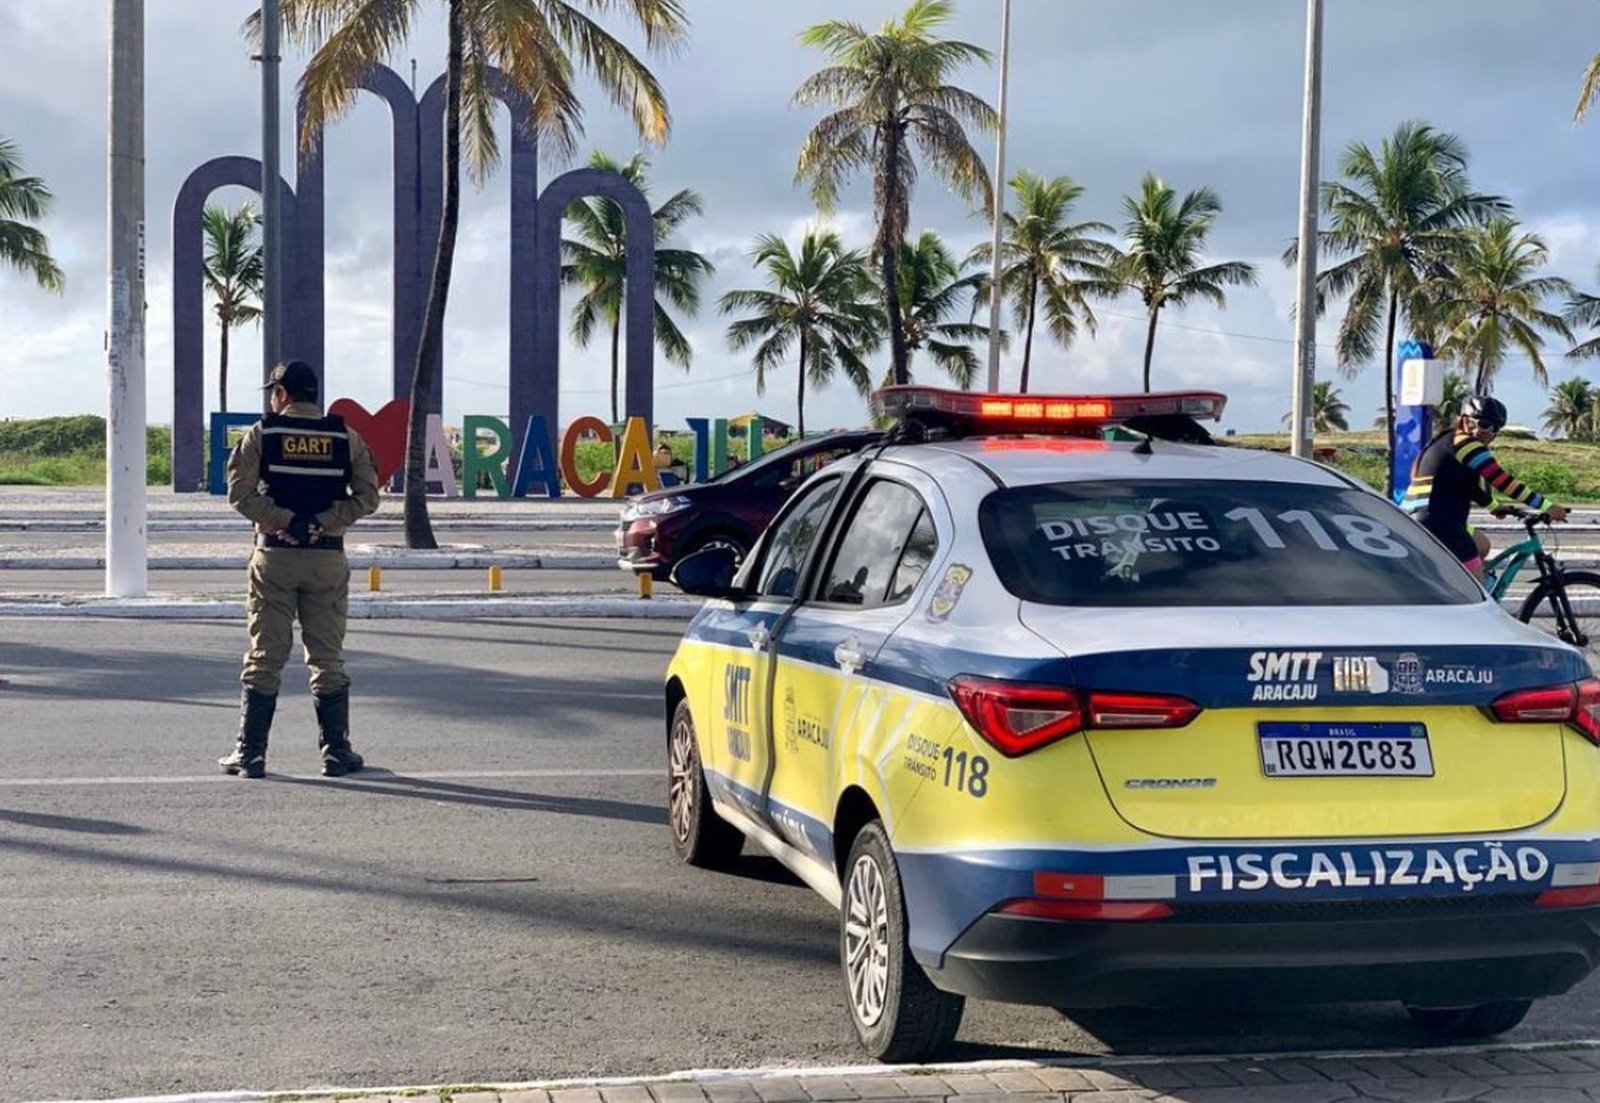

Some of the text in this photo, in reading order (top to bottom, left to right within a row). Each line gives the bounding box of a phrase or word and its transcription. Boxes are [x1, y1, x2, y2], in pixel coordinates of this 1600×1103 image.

[284, 436, 331, 453] GART
[1040, 510, 1209, 541] DISQUE
[1224, 506, 1409, 558] 118
[1247, 652, 1323, 682] SMTT
[1425, 668, 1493, 684] ARACAJU
[724, 662, 751, 726] SMTT
[1252, 685, 1318, 701] ARACAJU
[906, 732, 940, 761] DISQUE
[1329, 728, 1357, 736] BRASIL
[1276, 740, 1417, 770] RQW2C83
[943, 746, 989, 799] 118
[1187, 840, 1549, 891] FISCALIZAÇÃO
